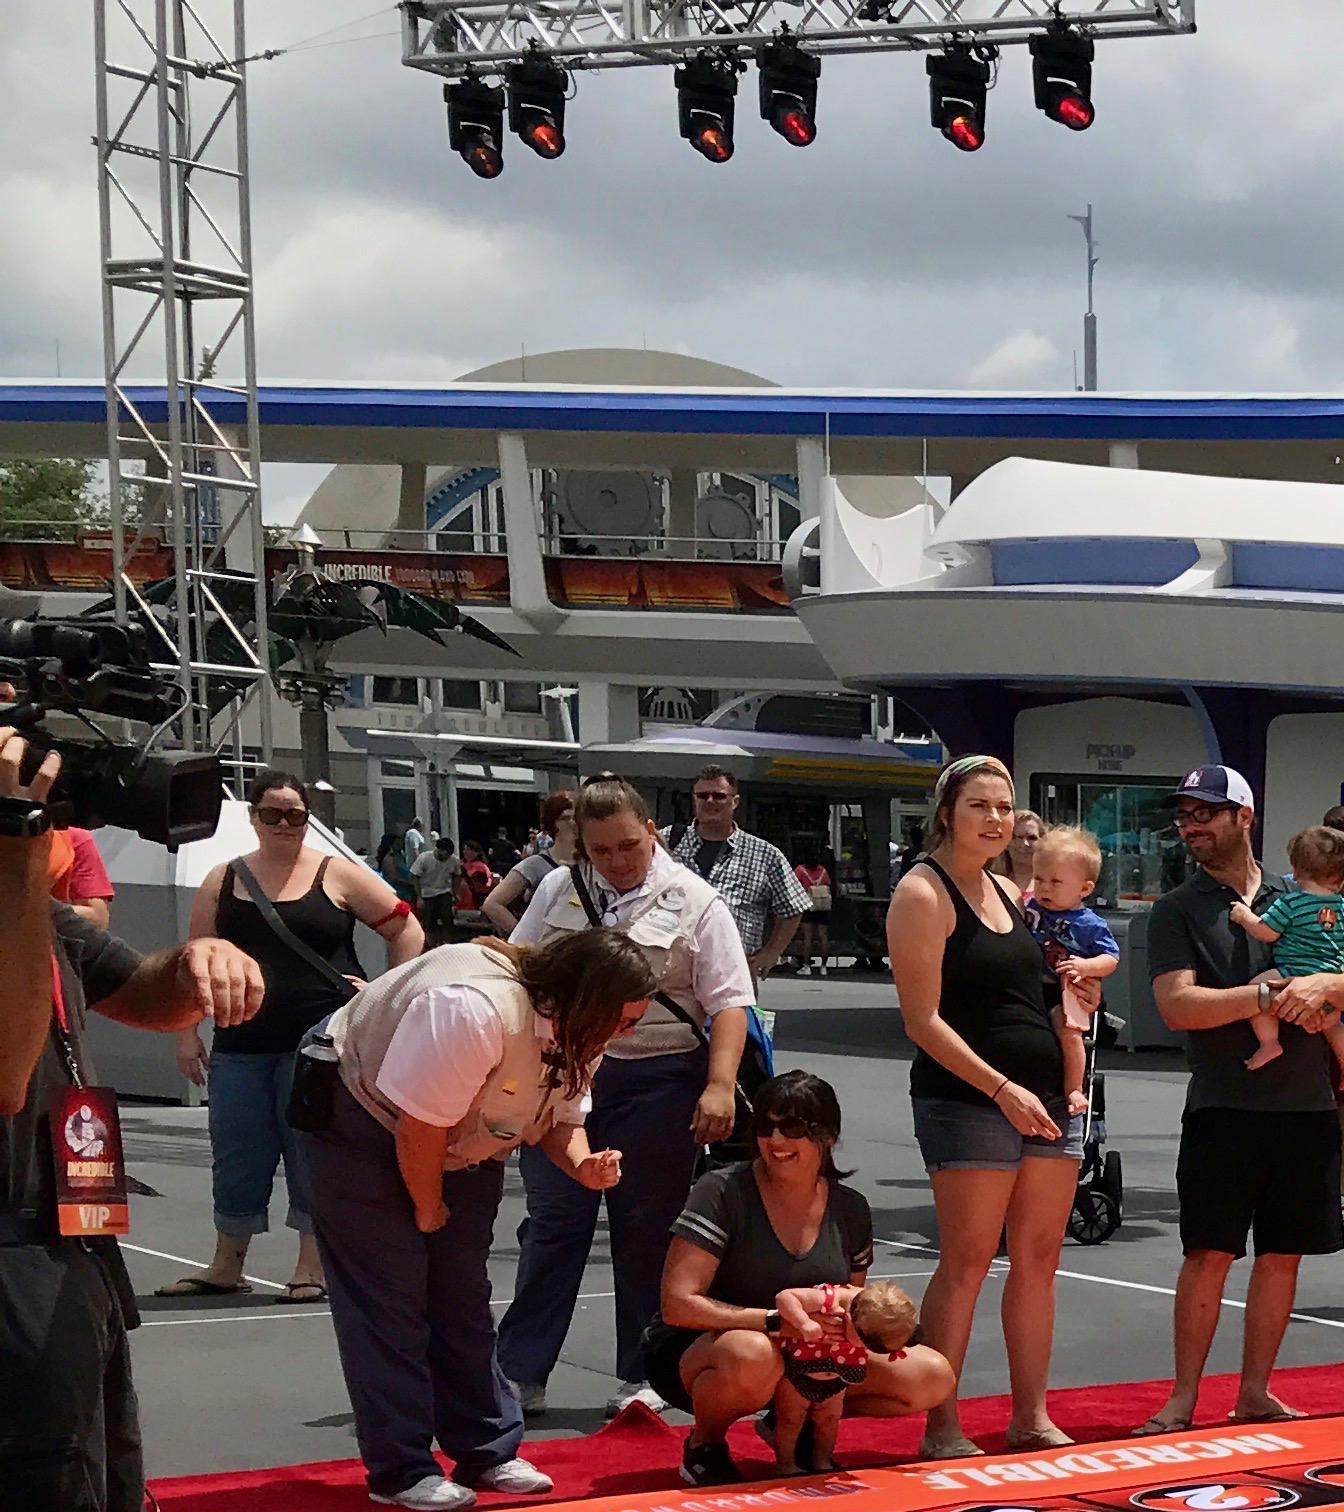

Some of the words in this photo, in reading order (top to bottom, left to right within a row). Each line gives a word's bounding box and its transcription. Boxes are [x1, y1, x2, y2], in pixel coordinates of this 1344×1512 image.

[324, 563, 393, 582] INCREDIBLE
[79, 1206, 110, 1229] VIP
[921, 1433, 1303, 1490] INCREDIBLE
